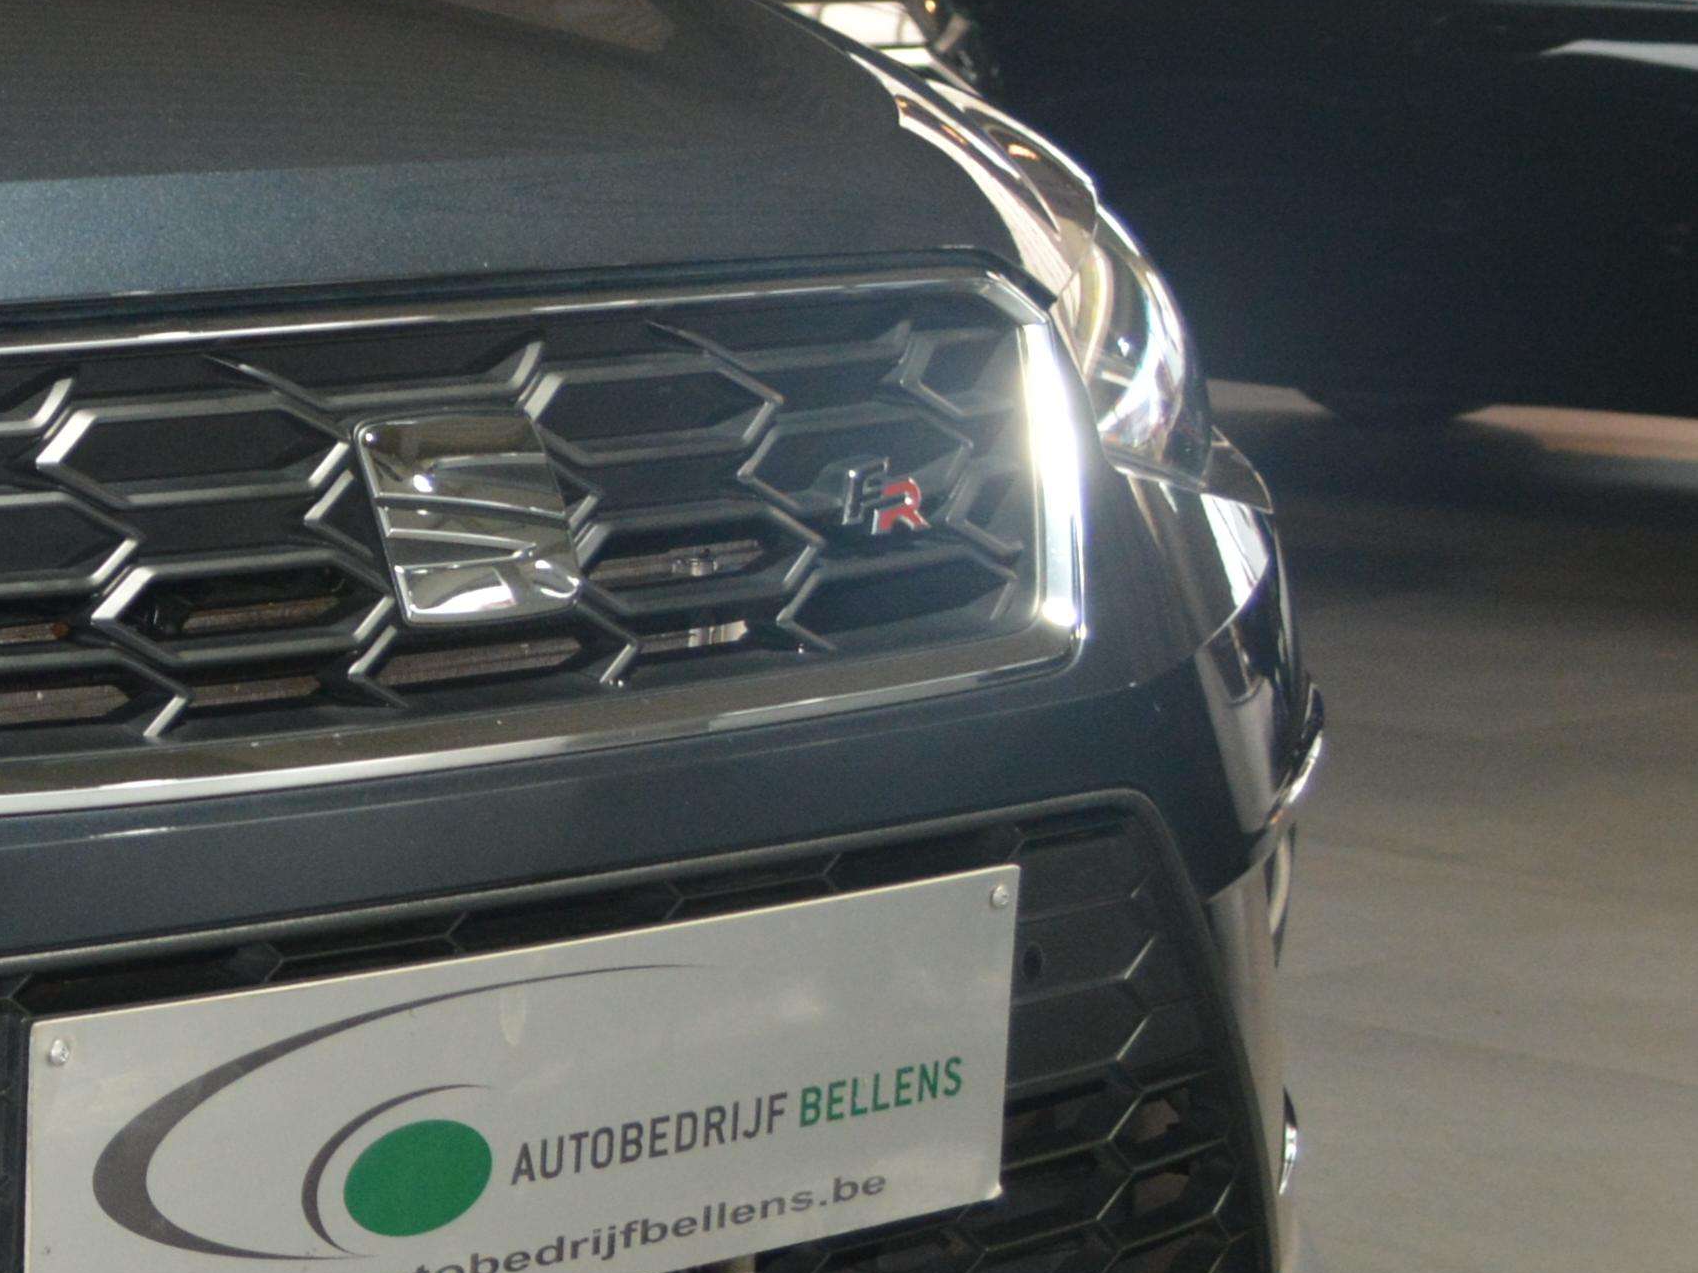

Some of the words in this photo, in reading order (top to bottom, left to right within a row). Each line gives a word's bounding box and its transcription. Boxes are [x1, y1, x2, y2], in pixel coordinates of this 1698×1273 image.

[841, 458, 932, 536] FR
[510, 1092, 788, 1186] AUTOBEDRIJF
[799, 1056, 963, 1127] BELLENS
